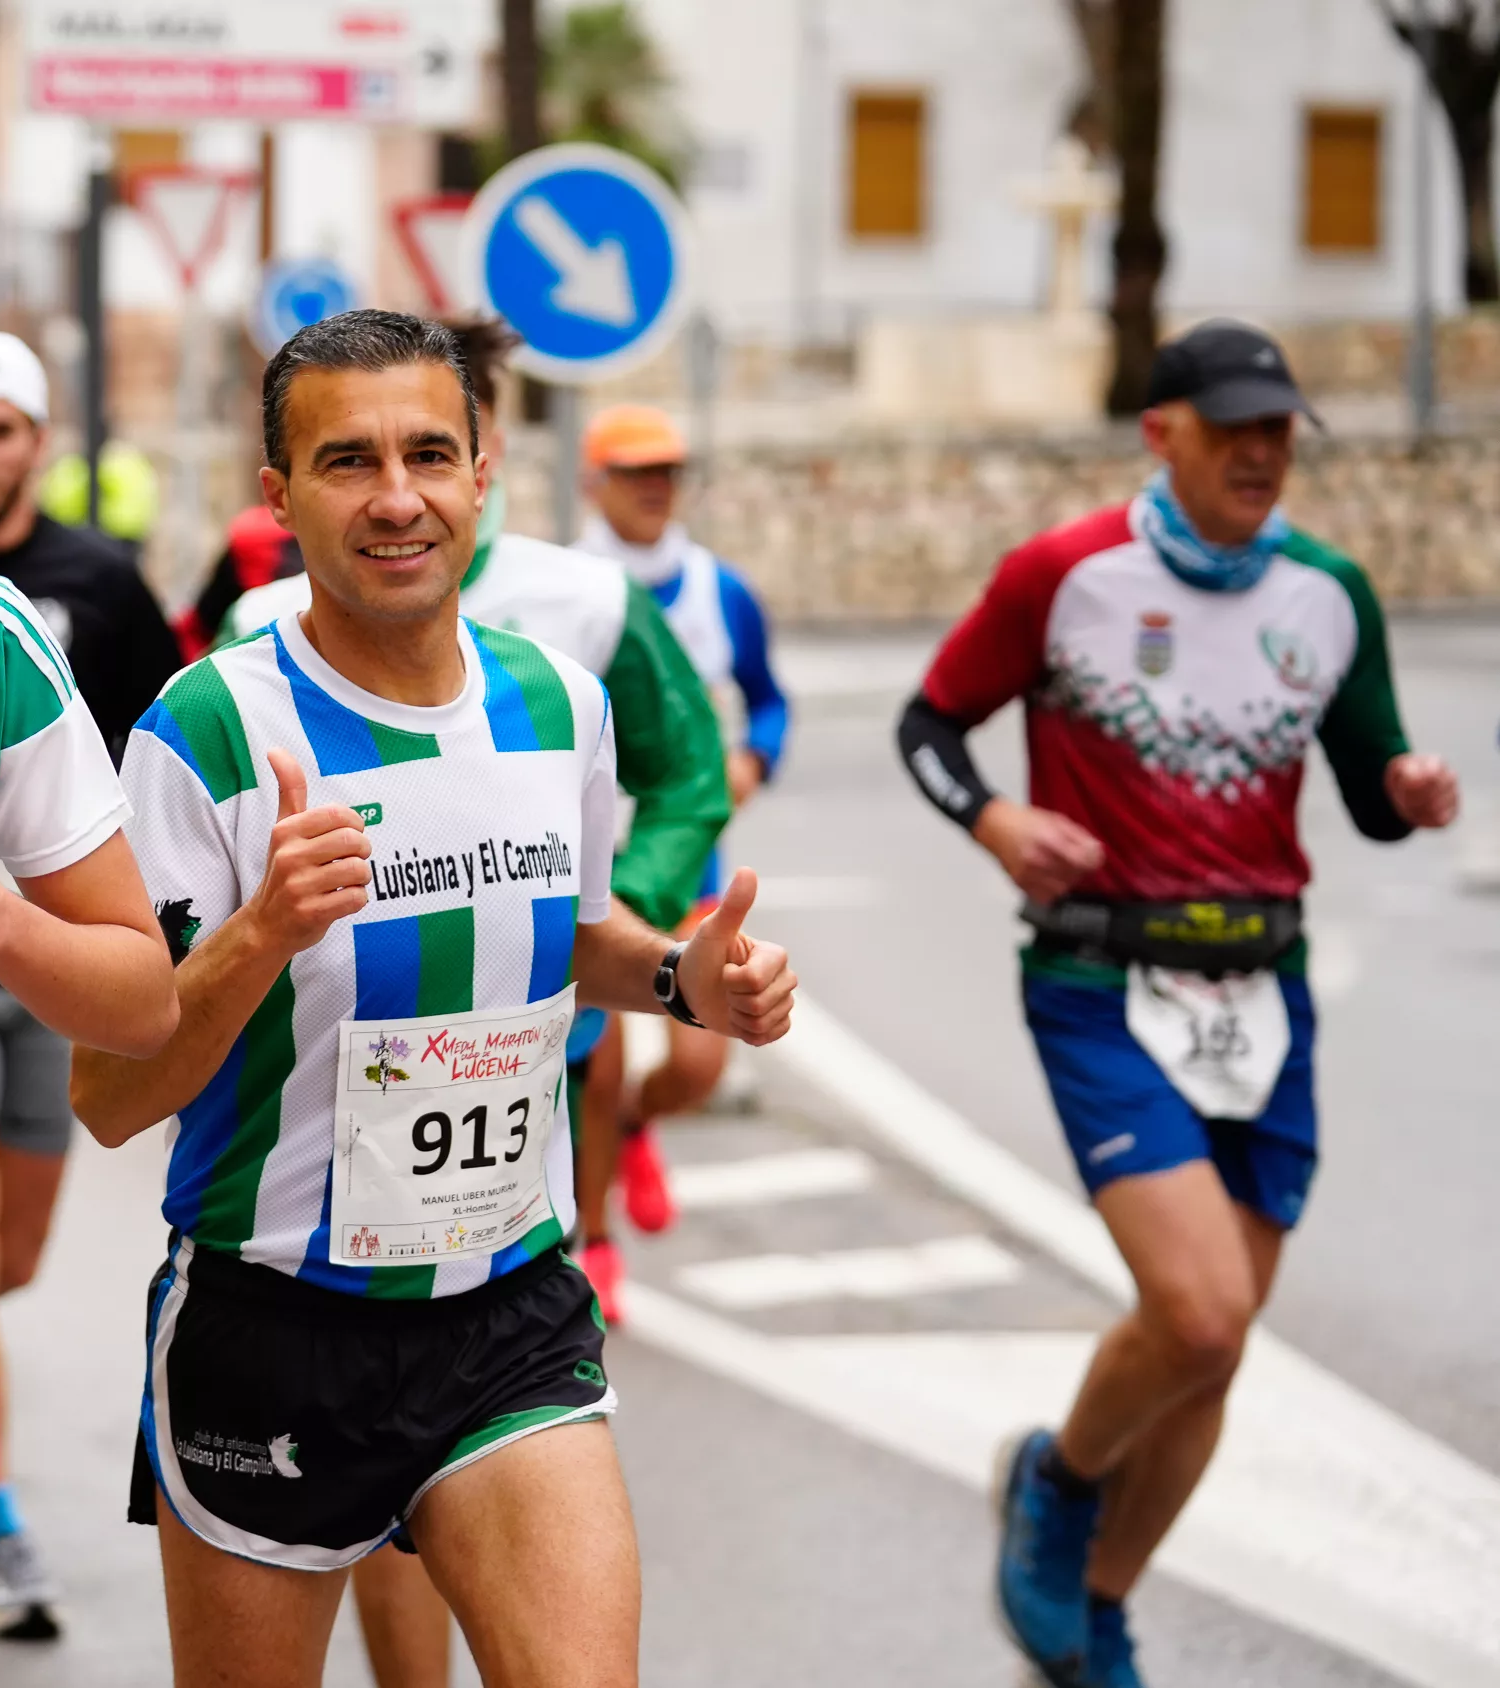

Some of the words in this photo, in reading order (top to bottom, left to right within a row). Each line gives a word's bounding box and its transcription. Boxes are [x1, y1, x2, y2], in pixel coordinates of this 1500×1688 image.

[370, 847, 460, 901] Luisiana
[462, 851, 474, 898] y
[479, 838, 501, 884] El
[503, 830, 572, 888] Campillo
[451, 1054, 528, 1081] LUCENA
[412, 1097, 530, 1175] 913
[422, 1193, 460, 1205] MANUEL
[462, 1190, 486, 1201] UBER
[452, 1202, 498, 1215] XL-Hombre
[195, 1428, 211, 1445] club
[213, 1432, 224, 1448] de
[226, 1436, 267, 1456] atletismo
[183, 1440, 214, 1467] Luisiana
[215, 1453, 222, 1472] y
[223, 1451, 232, 1470] El
[234, 1453, 273, 1477] Campillo
